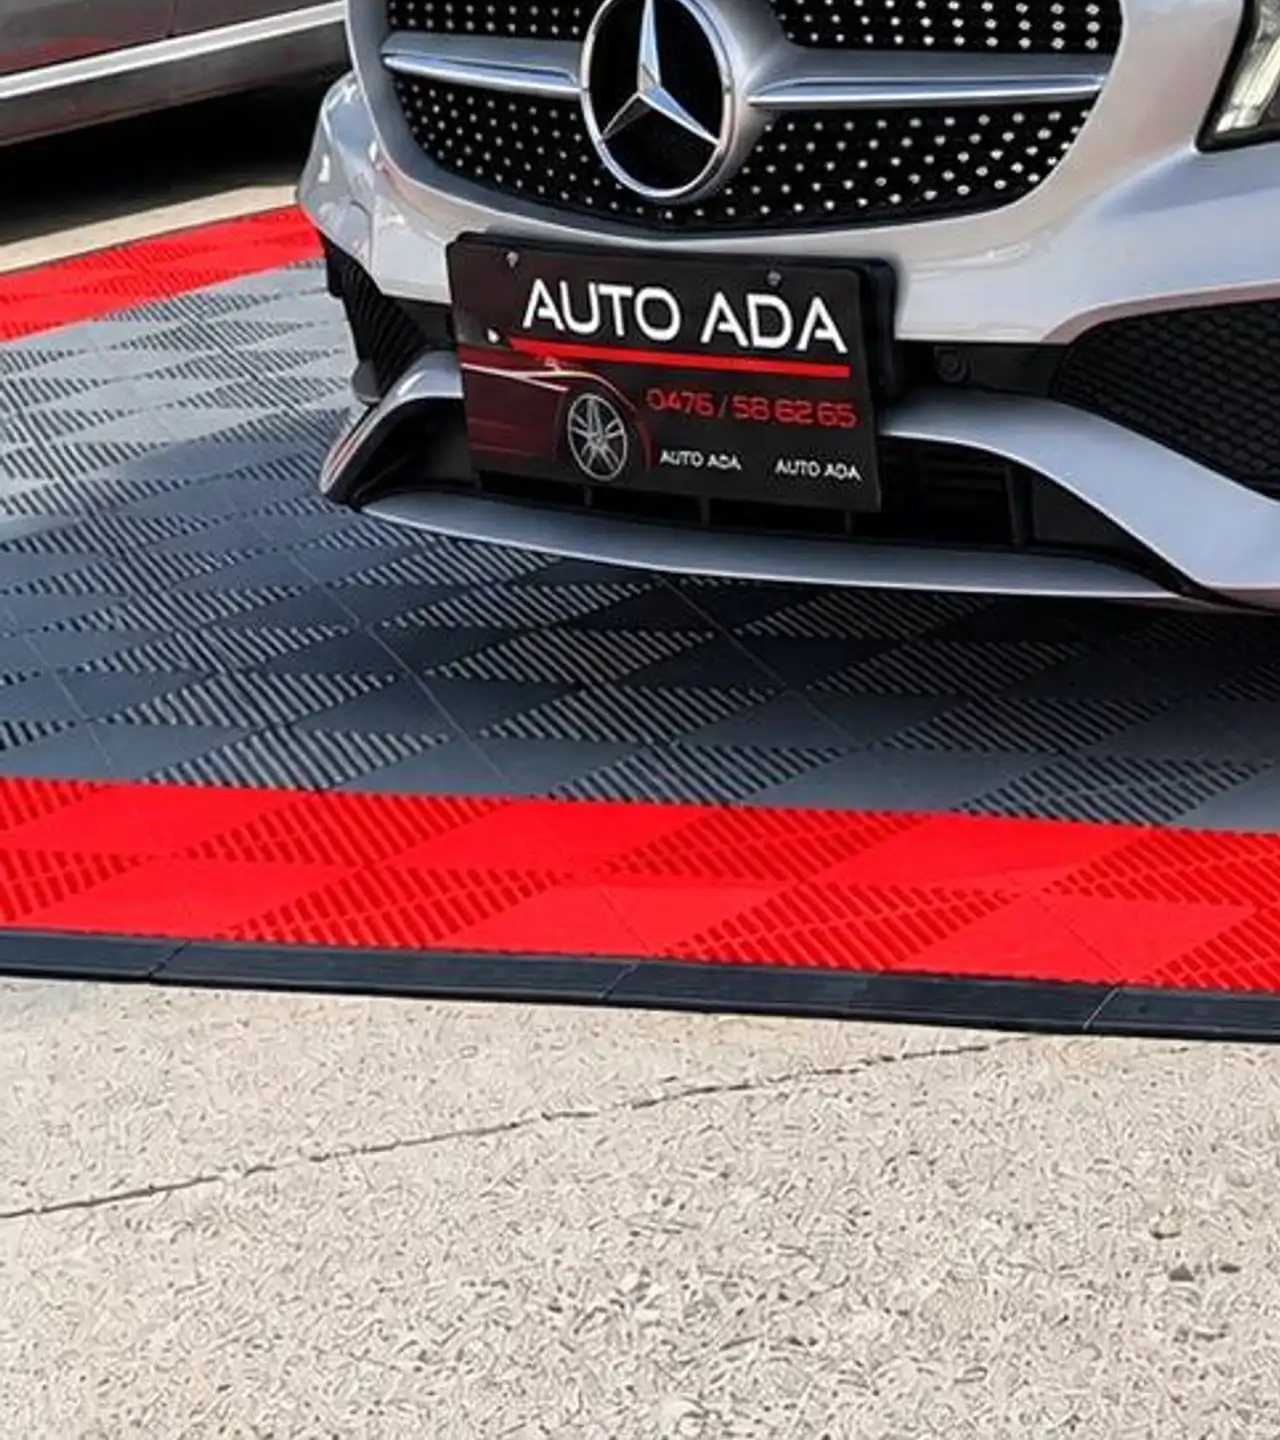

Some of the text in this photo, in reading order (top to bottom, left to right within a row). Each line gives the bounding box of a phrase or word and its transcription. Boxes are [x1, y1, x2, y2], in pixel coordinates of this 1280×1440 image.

[523, 277, 848, 354] AUTO ADA
[646, 387, 715, 417] 0476
[733, 394, 770, 421] 58
[774, 398, 815, 424] 62
[817, 401, 858, 429] 65
[660, 449, 742, 471] AUTO ADA
[774, 458, 862, 481] AUTO ADA
